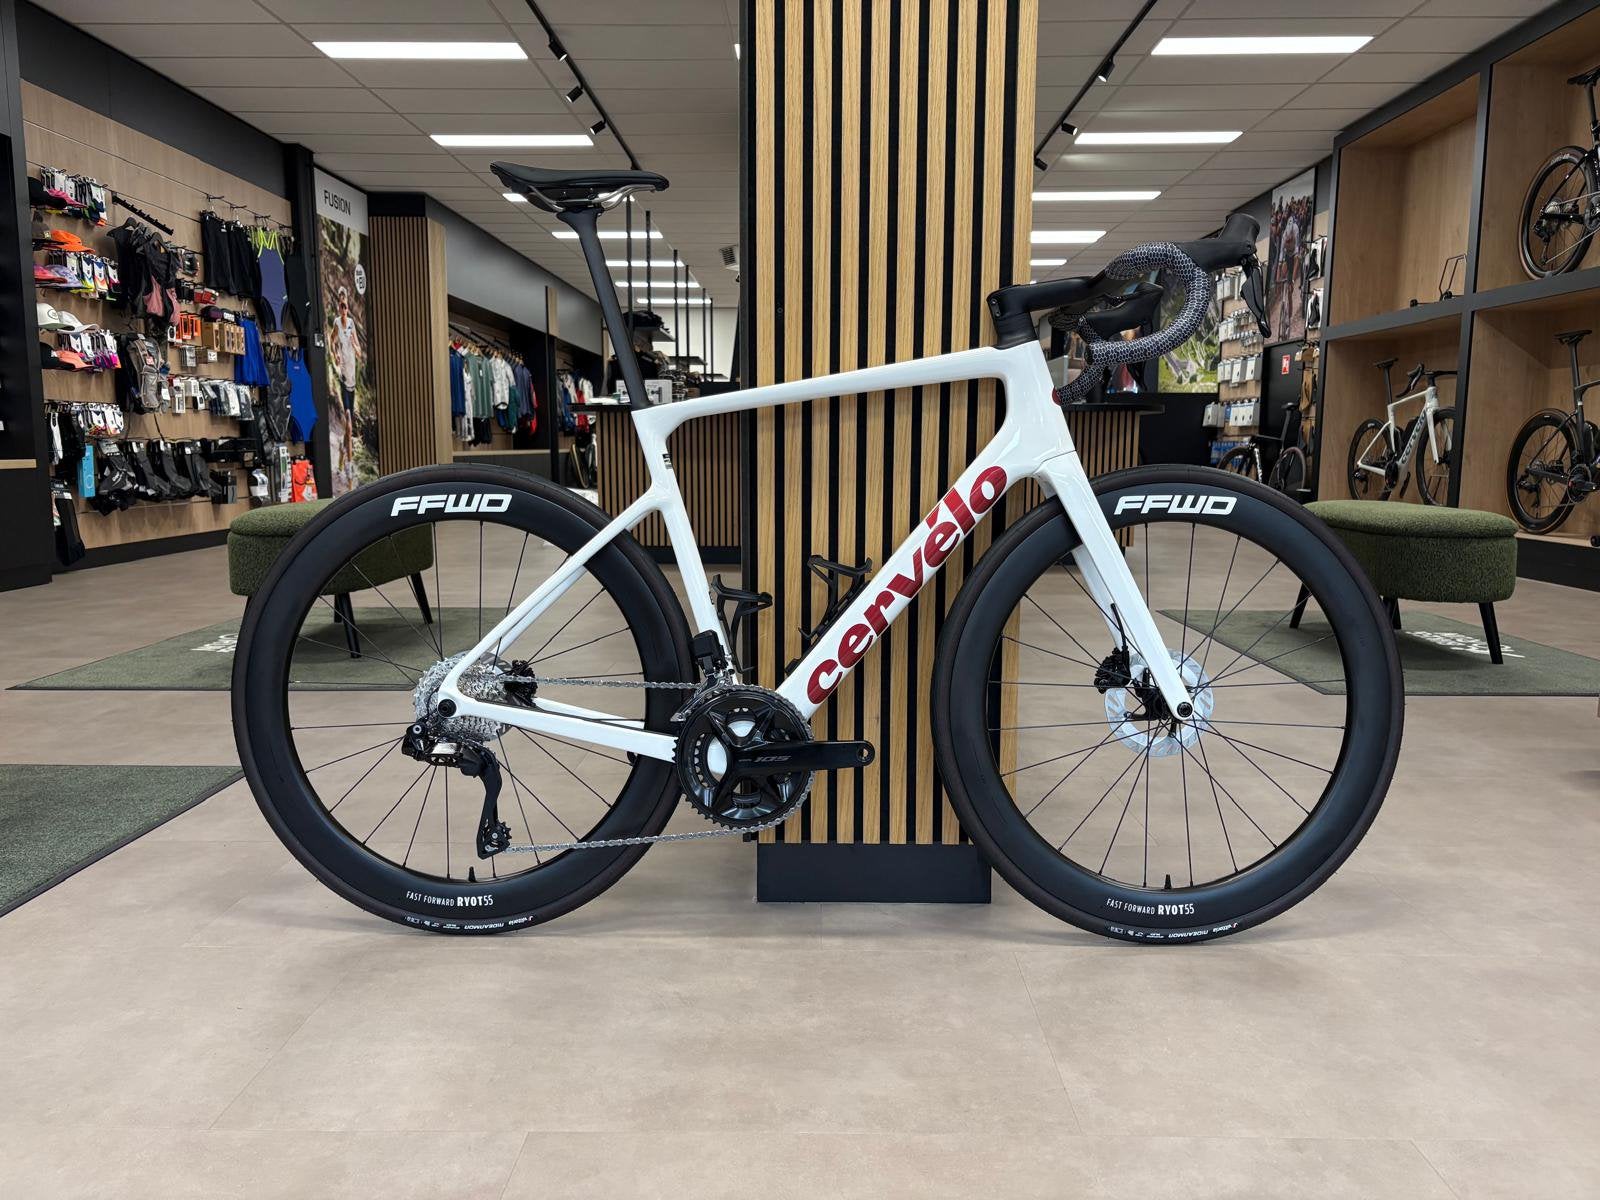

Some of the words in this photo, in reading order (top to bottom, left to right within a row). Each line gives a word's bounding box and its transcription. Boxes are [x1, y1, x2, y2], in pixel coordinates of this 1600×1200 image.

[324, 190, 351, 216] FUSION
[390, 493, 513, 517] FFWD
[1113, 494, 1238, 516] FFWD
[807, 465, 1008, 705] cervélo
[406, 891, 422, 902] FAST
[423, 895, 455, 907] FORWARD
[1106, 898, 1123, 910] FAST
[1123, 902, 1155, 915] FORWARD
